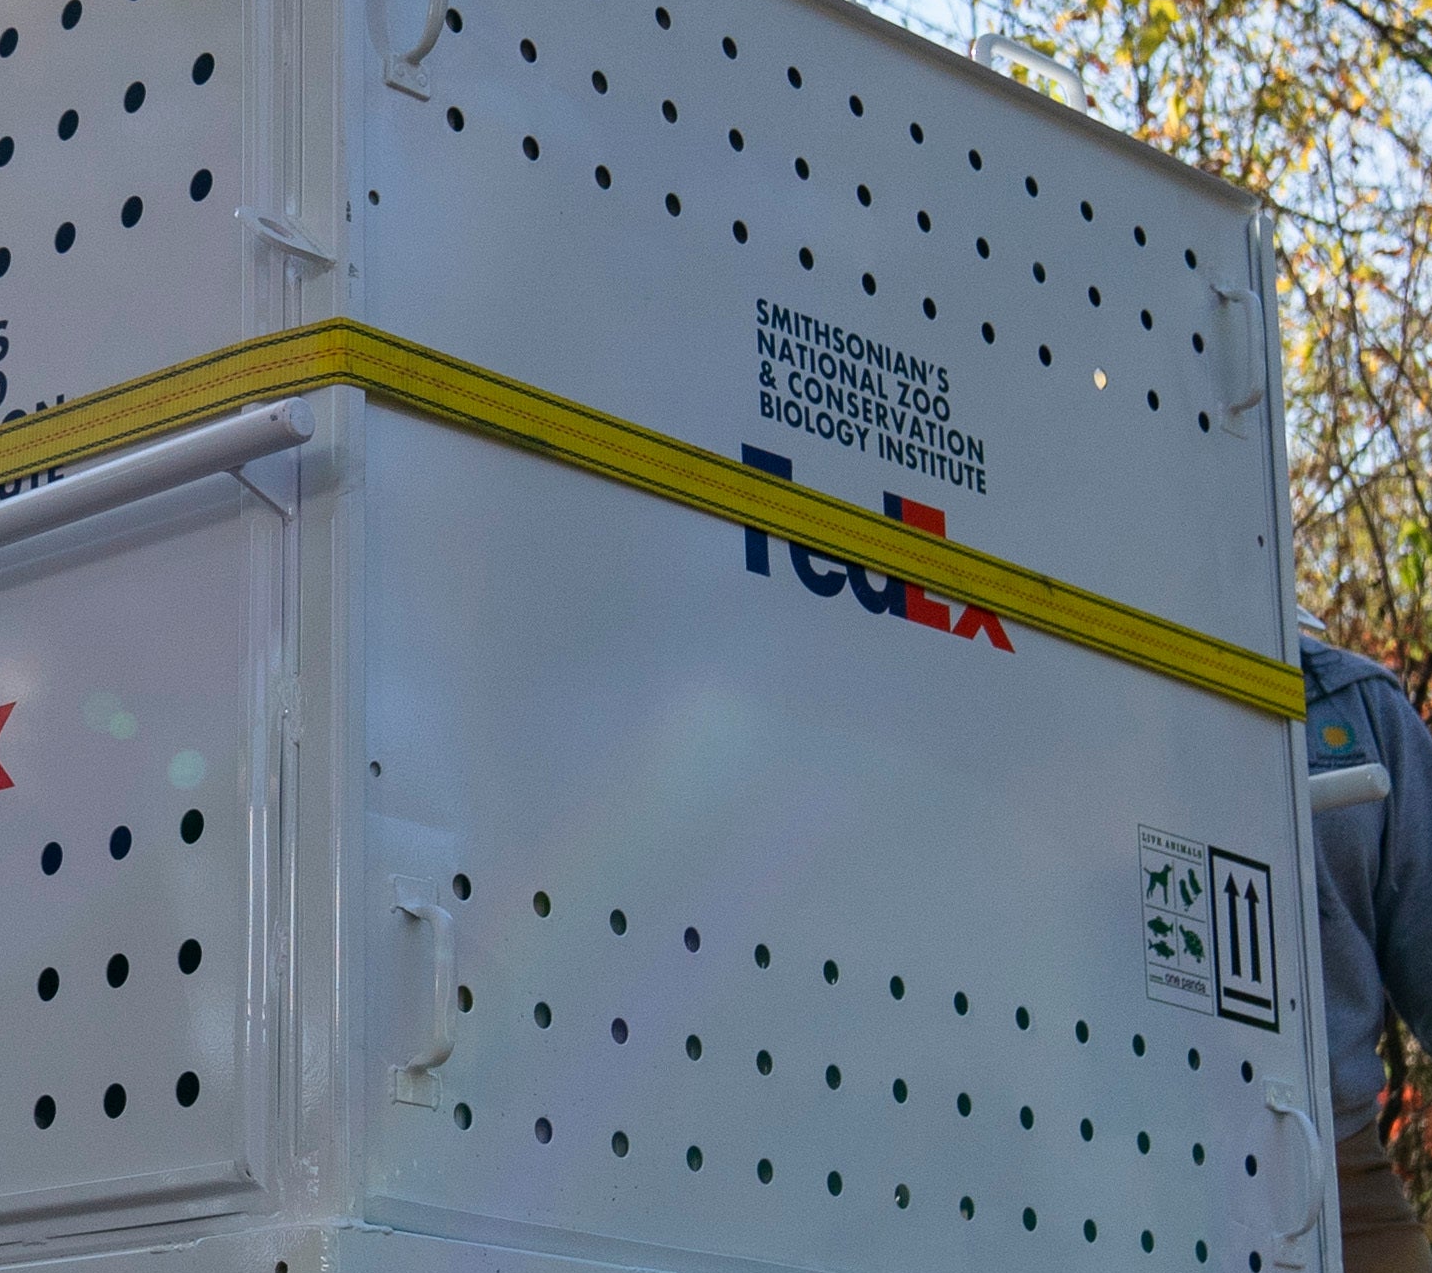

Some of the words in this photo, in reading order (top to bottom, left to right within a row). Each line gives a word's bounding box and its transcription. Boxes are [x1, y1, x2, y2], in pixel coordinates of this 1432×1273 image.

[756, 298, 949, 393] SMITHSONIAN'S
[757, 328, 888, 400] NATIONAL
[897, 381, 950, 422] ZOO
[759, 360, 778, 391] &
[788, 371, 984, 465] CONSERVATION
[760, 391, 870, 452] BIOLOGY
[878, 432, 987, 495] INSTITUTE
